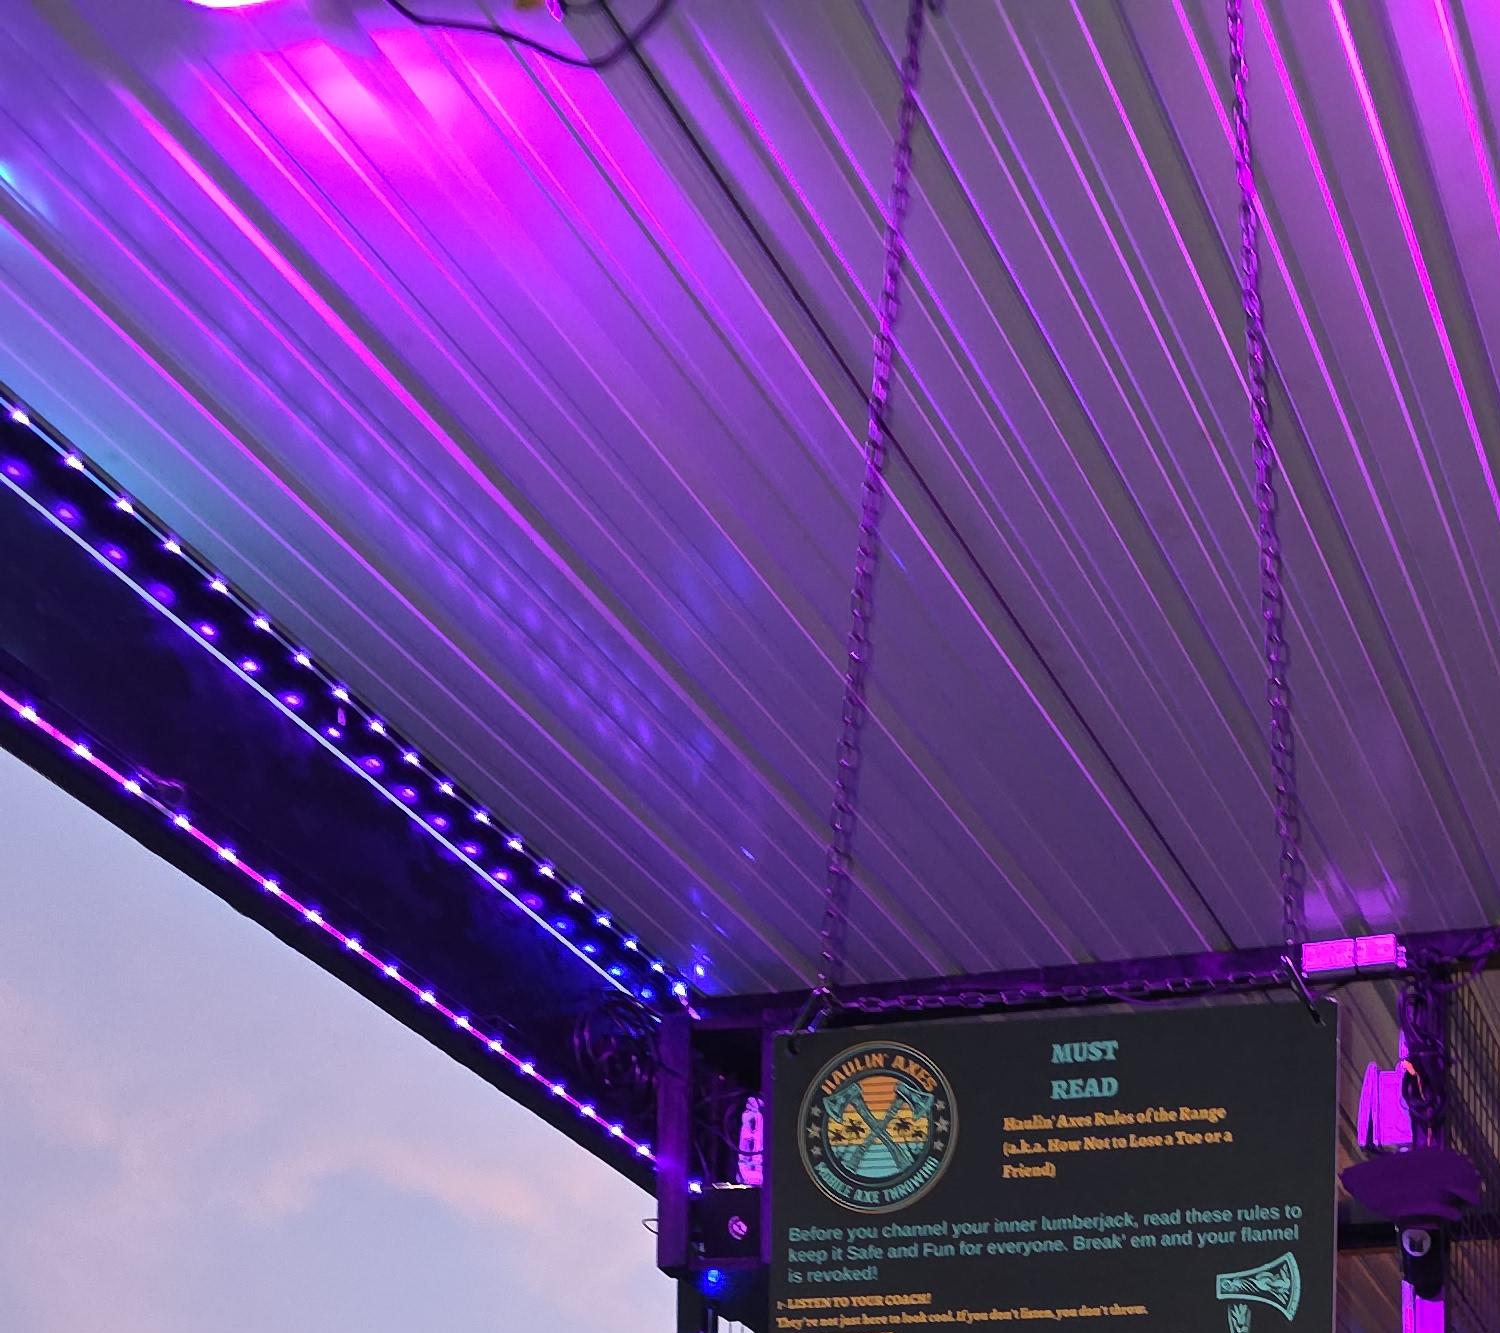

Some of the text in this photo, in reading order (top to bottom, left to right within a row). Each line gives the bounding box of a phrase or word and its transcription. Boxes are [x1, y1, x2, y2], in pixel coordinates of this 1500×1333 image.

[1051, 1040, 1118, 1063] MUST
[821, 1054, 938, 1093] HAULIN' AXES
[1050, 1077, 1118, 1100] READ
[1003, 1107, 1226, 1131] Haulin' Axes Rules of the Range
[1002, 1161, 1056, 1178] Friend)
[789, 1205, 1302, 1243] Before you channel your inner lumberjack, read these rules to
[788, 1248, 828, 1264] keep
[831, 1246, 843, 1261] it
[846, 1245, 883, 1260] Safe
[887, 1242, 918, 1258] and
[923, 1243, 955, 1257] Fun
[959, 1241, 983, 1255] for
[987, 1240, 1068, 1256] everyone.
[1130, 1235, 1156, 1248] em
[1160, 1229, 1192, 1246] and
[1197, 1231, 1236, 1248] your
[1241, 1225, 1298, 1242] flannel
[788, 1265, 877, 1283] is revoked!
